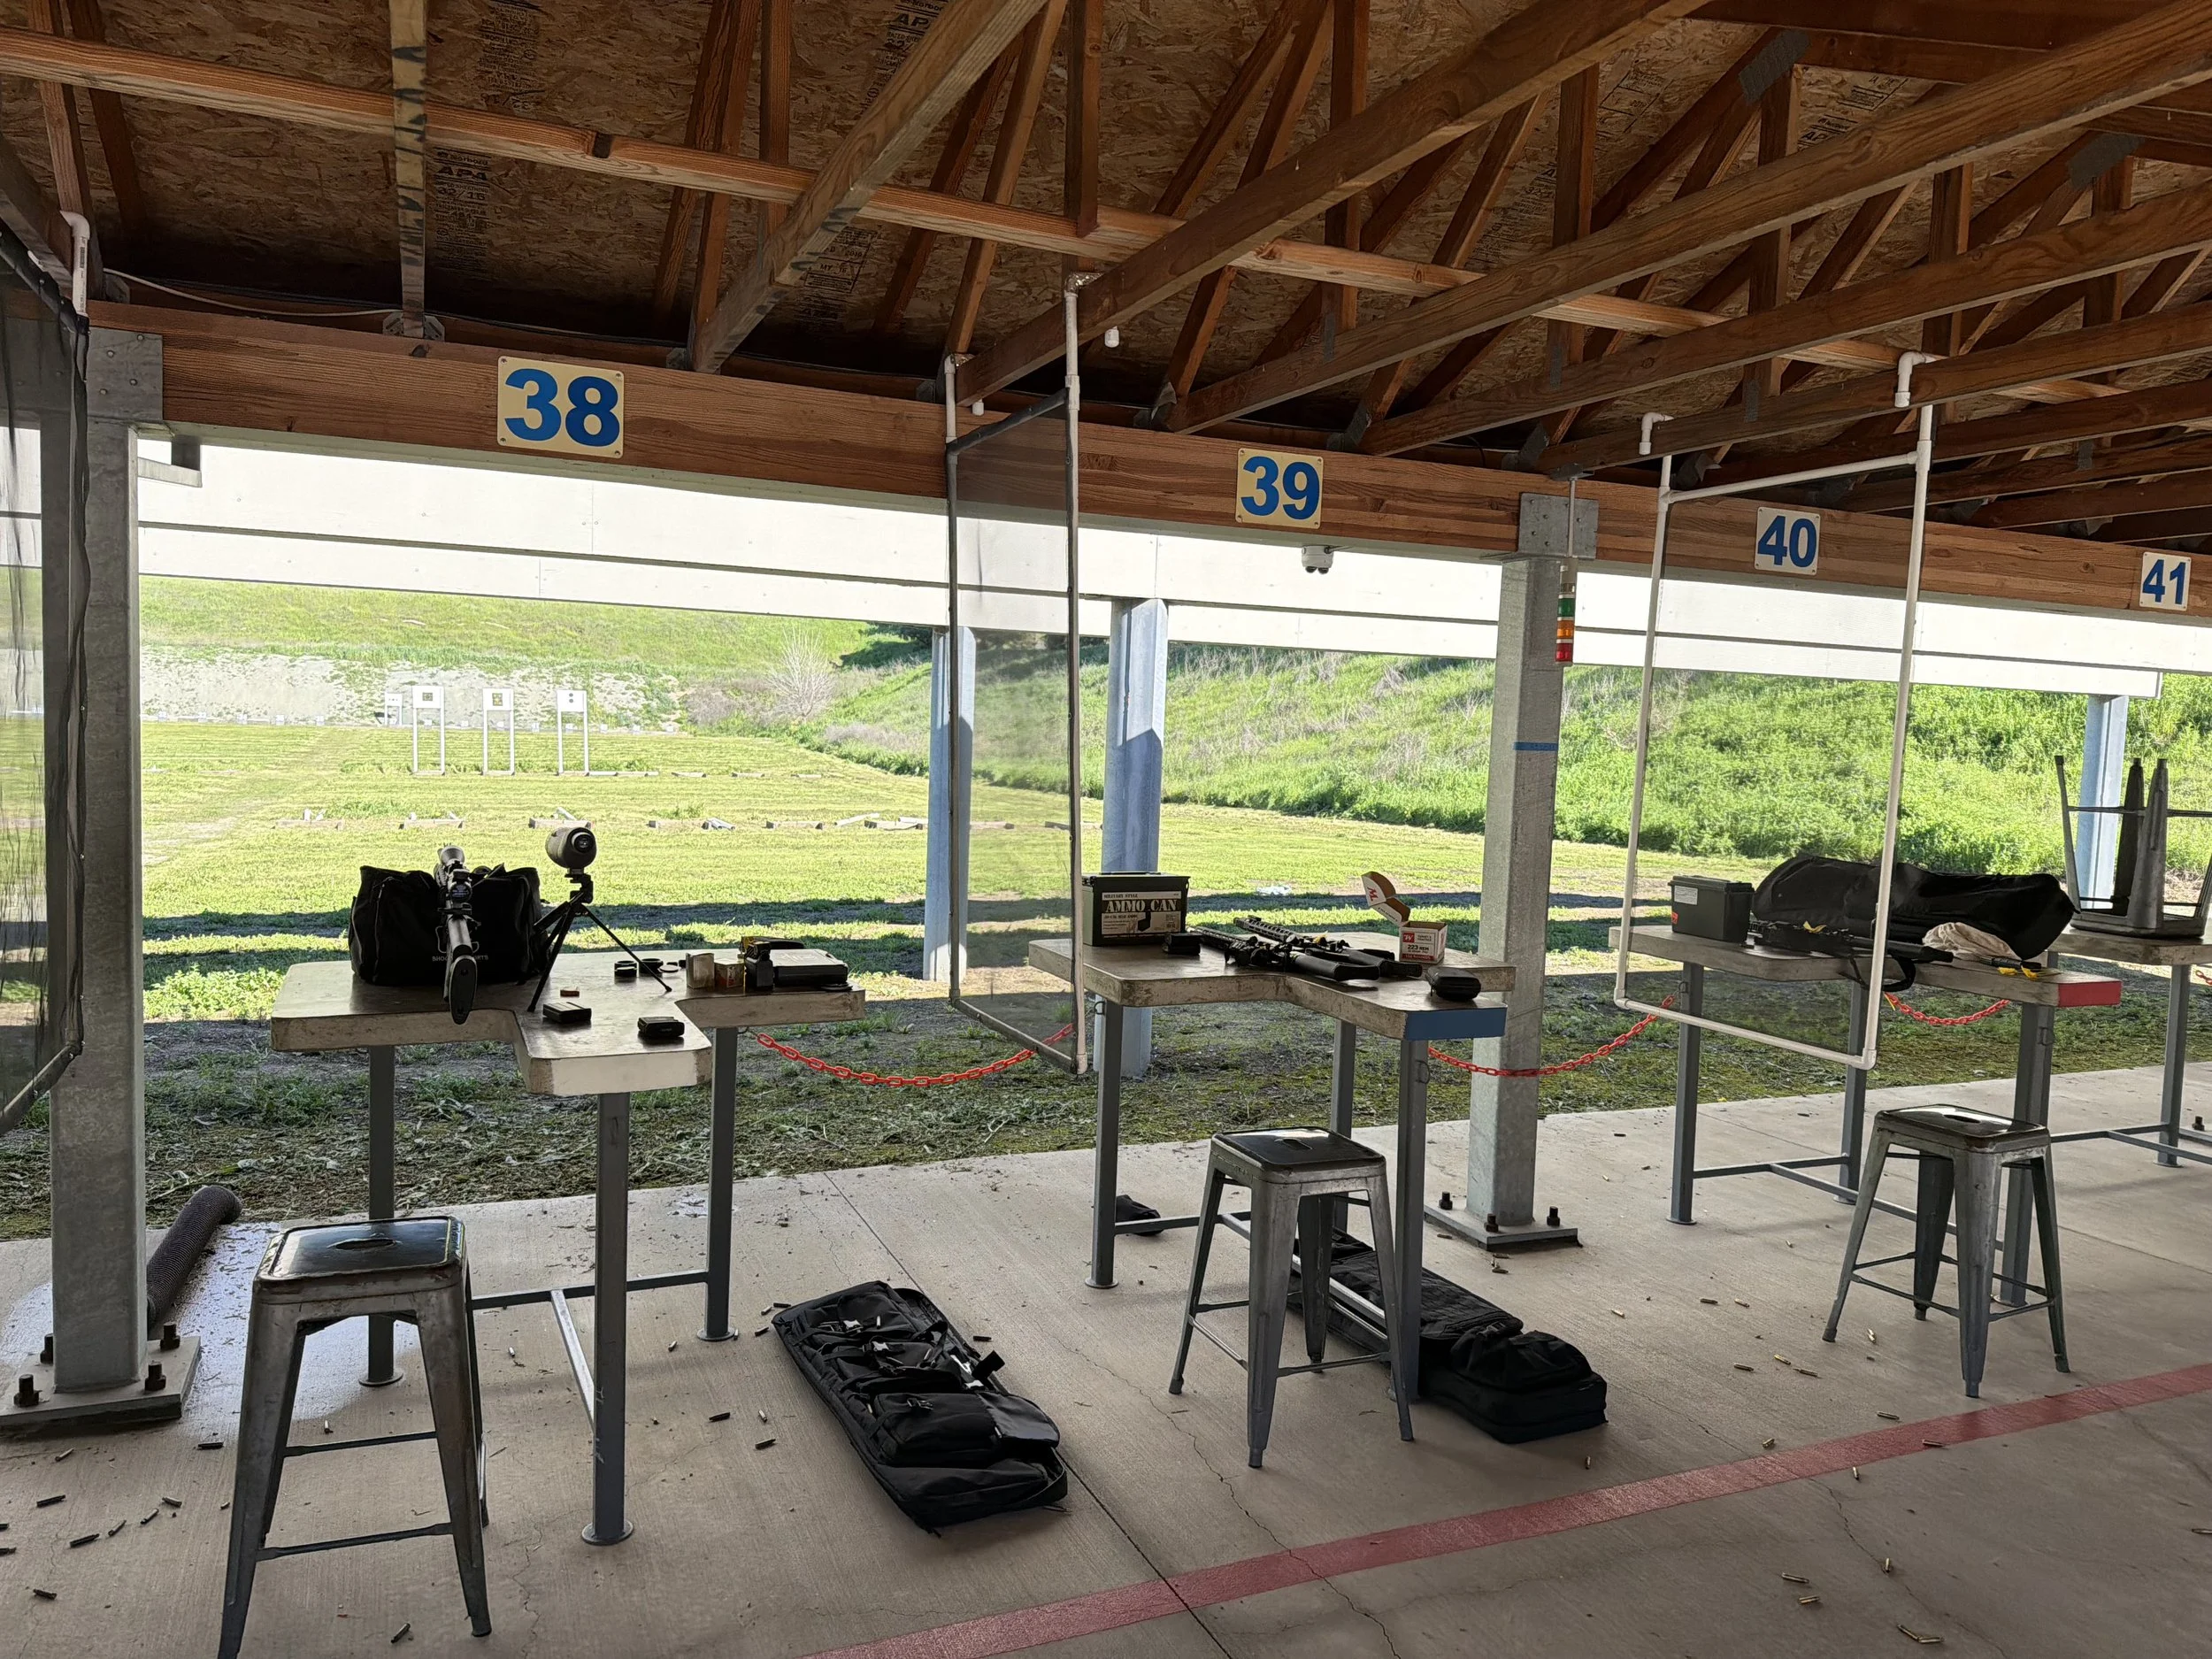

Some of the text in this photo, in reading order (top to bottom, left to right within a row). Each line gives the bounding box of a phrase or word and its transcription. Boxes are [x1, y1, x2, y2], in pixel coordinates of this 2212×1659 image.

[895, 13, 931, 30] AP
[506, 368, 619, 447] 38
[1241, 456, 1320, 520] 39
[1758, 516, 1816, 567] 40
[2143, 560, 2185, 603] 41
[1105, 899, 1177, 913] AMMO CAN
